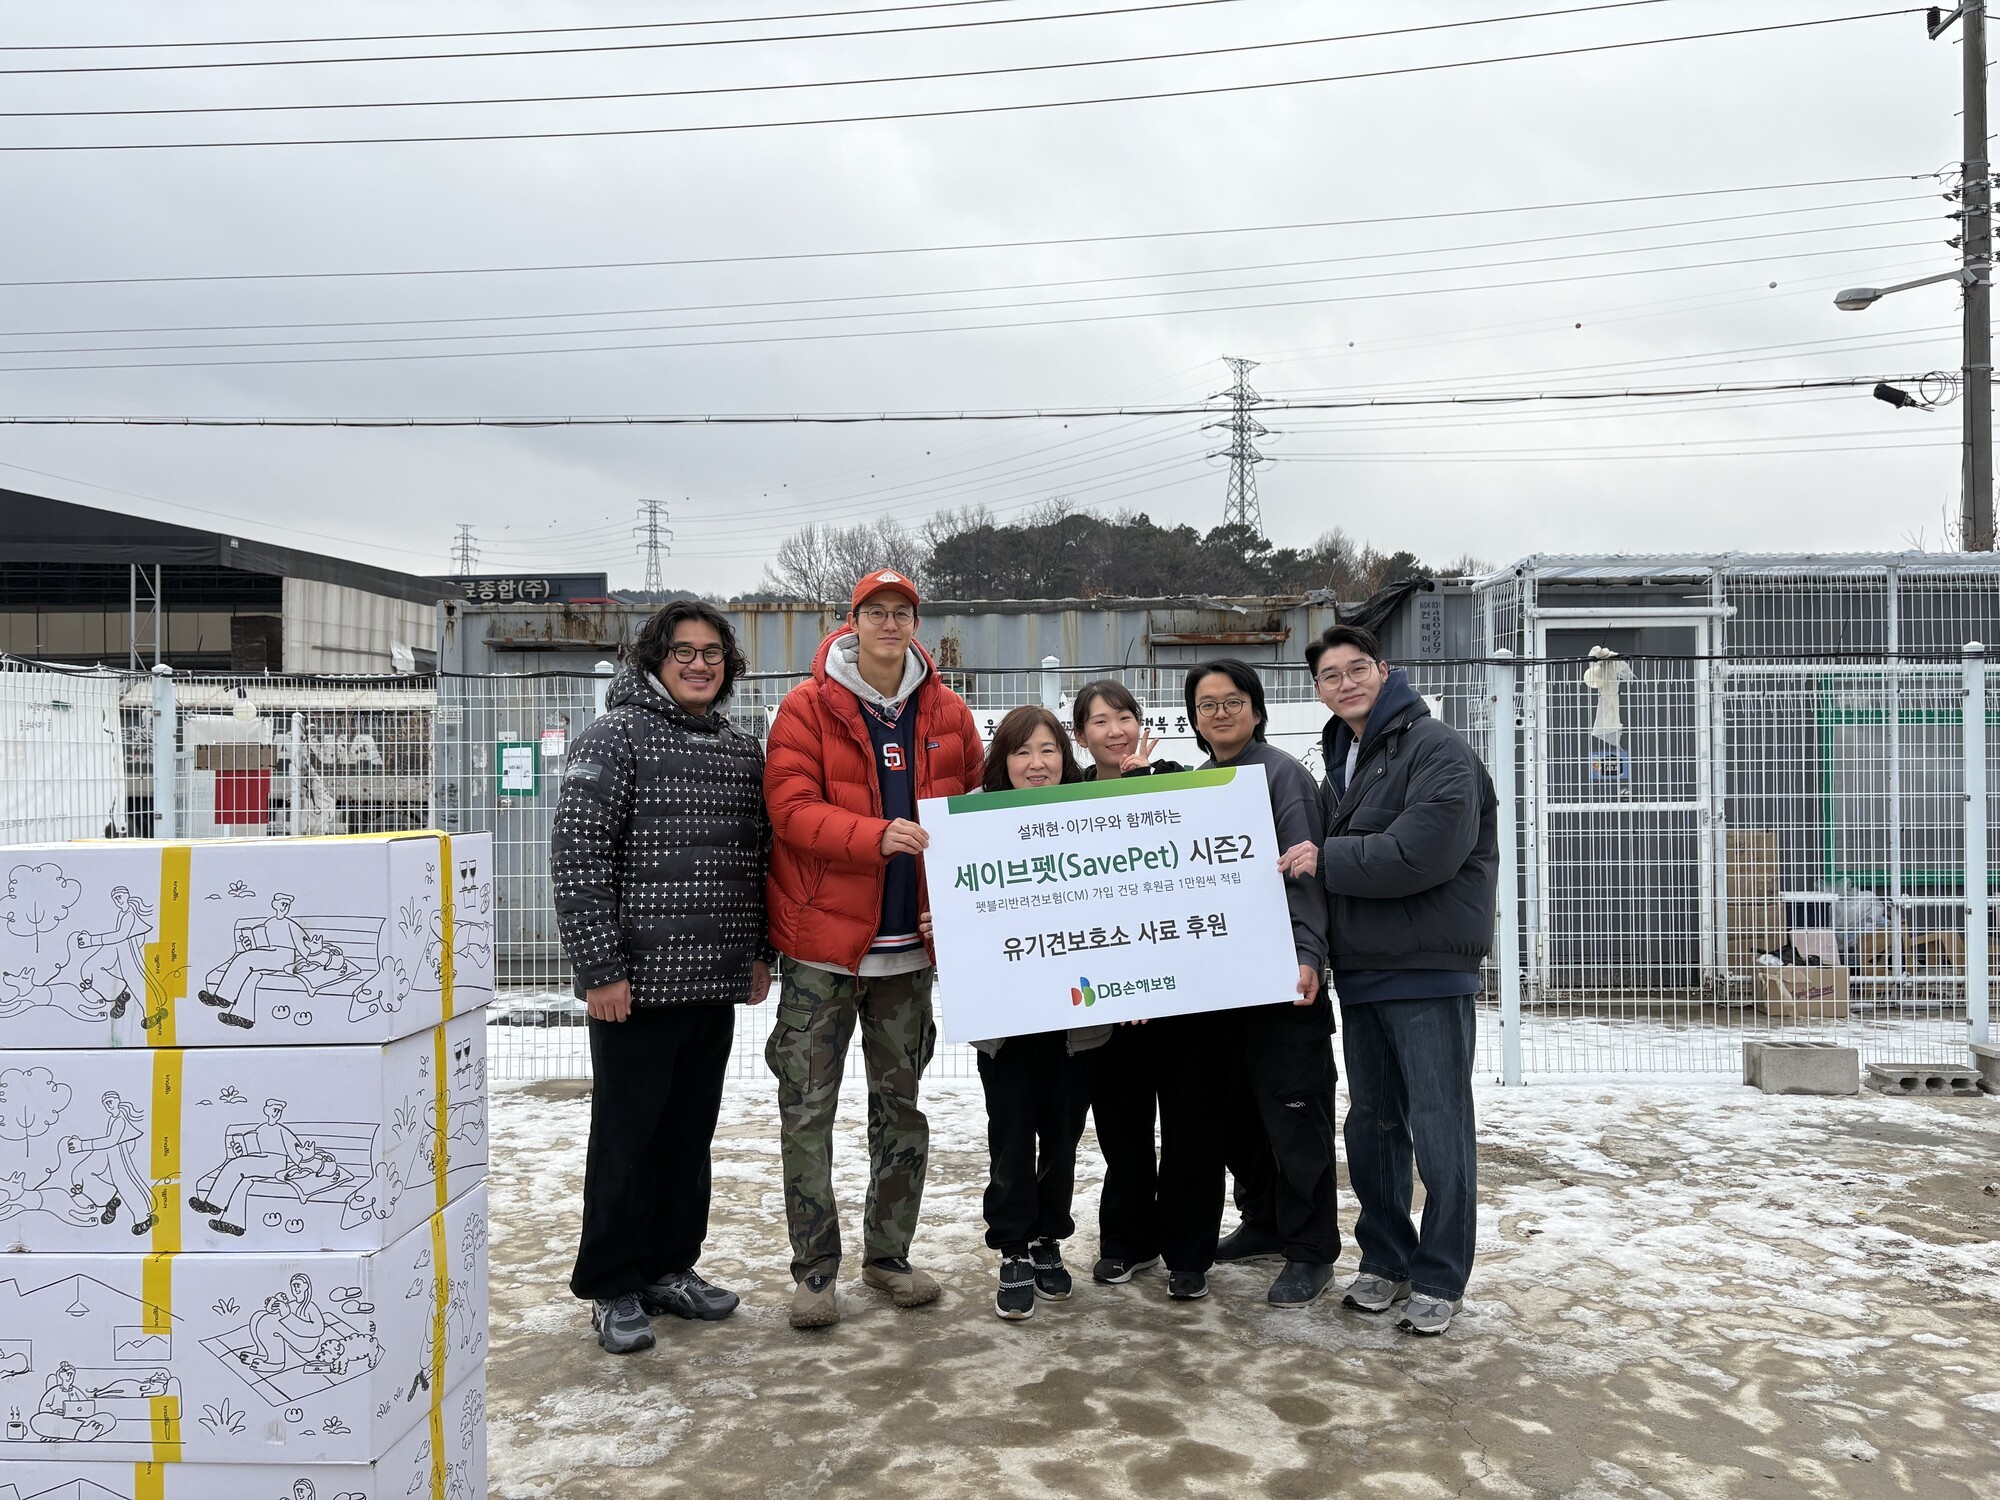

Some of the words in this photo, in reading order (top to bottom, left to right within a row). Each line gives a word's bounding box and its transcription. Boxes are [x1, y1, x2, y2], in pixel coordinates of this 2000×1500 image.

[883, 743, 907, 771] SD
[1017, 814, 1122, 841] 설채현·이기우와
[1125, 808, 1182, 829] 함께하는
[953, 840, 1179, 892] 세이브펫(SavePet)
[1189, 834, 1255, 866] 시즌2
[975, 888, 1089, 914] 펫블리반려견보험(CM)
[1092, 886, 1114, 899] 가입
[1117, 883, 1139, 897] 건당
[1142, 879, 1175, 894] 후원금
[1178, 874, 1217, 890] 1만원씩
[1220, 871, 1241, 885] 적립
[1002, 925, 1132, 962] 유기견보호소
[1137, 919, 1181, 945] 사료
[1186, 912, 1229, 940] 후원
[1097, 975, 1176, 1000] DB손해보험
